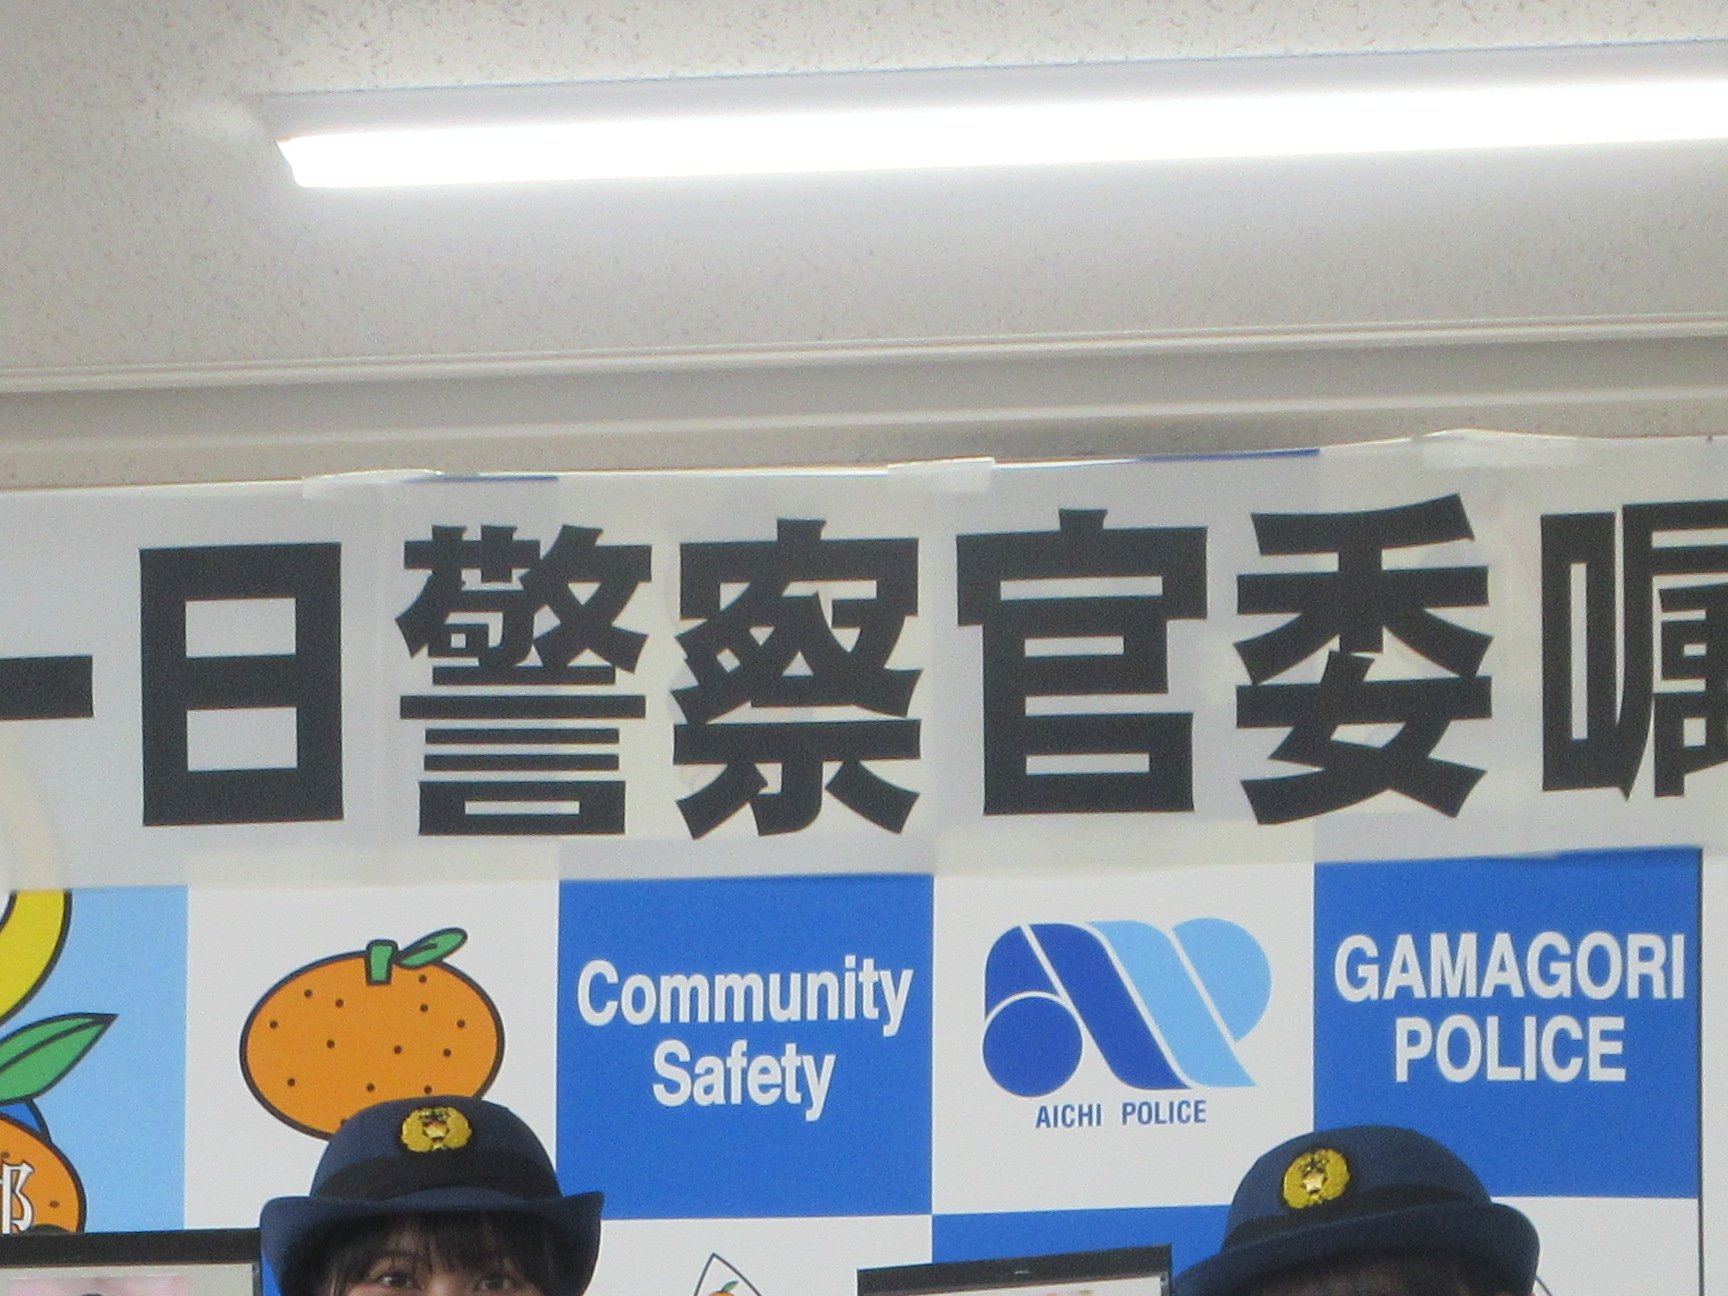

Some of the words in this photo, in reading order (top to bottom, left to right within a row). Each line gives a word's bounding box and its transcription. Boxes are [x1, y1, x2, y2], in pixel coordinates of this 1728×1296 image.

[578, 956, 913, 1038] Community
[1334, 931, 1686, 1001] GAMAGORI
[653, 1040, 836, 1121] Safety
[1395, 1014, 1626, 1084] POLICE
[1035, 1102, 1102, 1130] AICHI
[1121, 1099, 1207, 1127] POLICE
